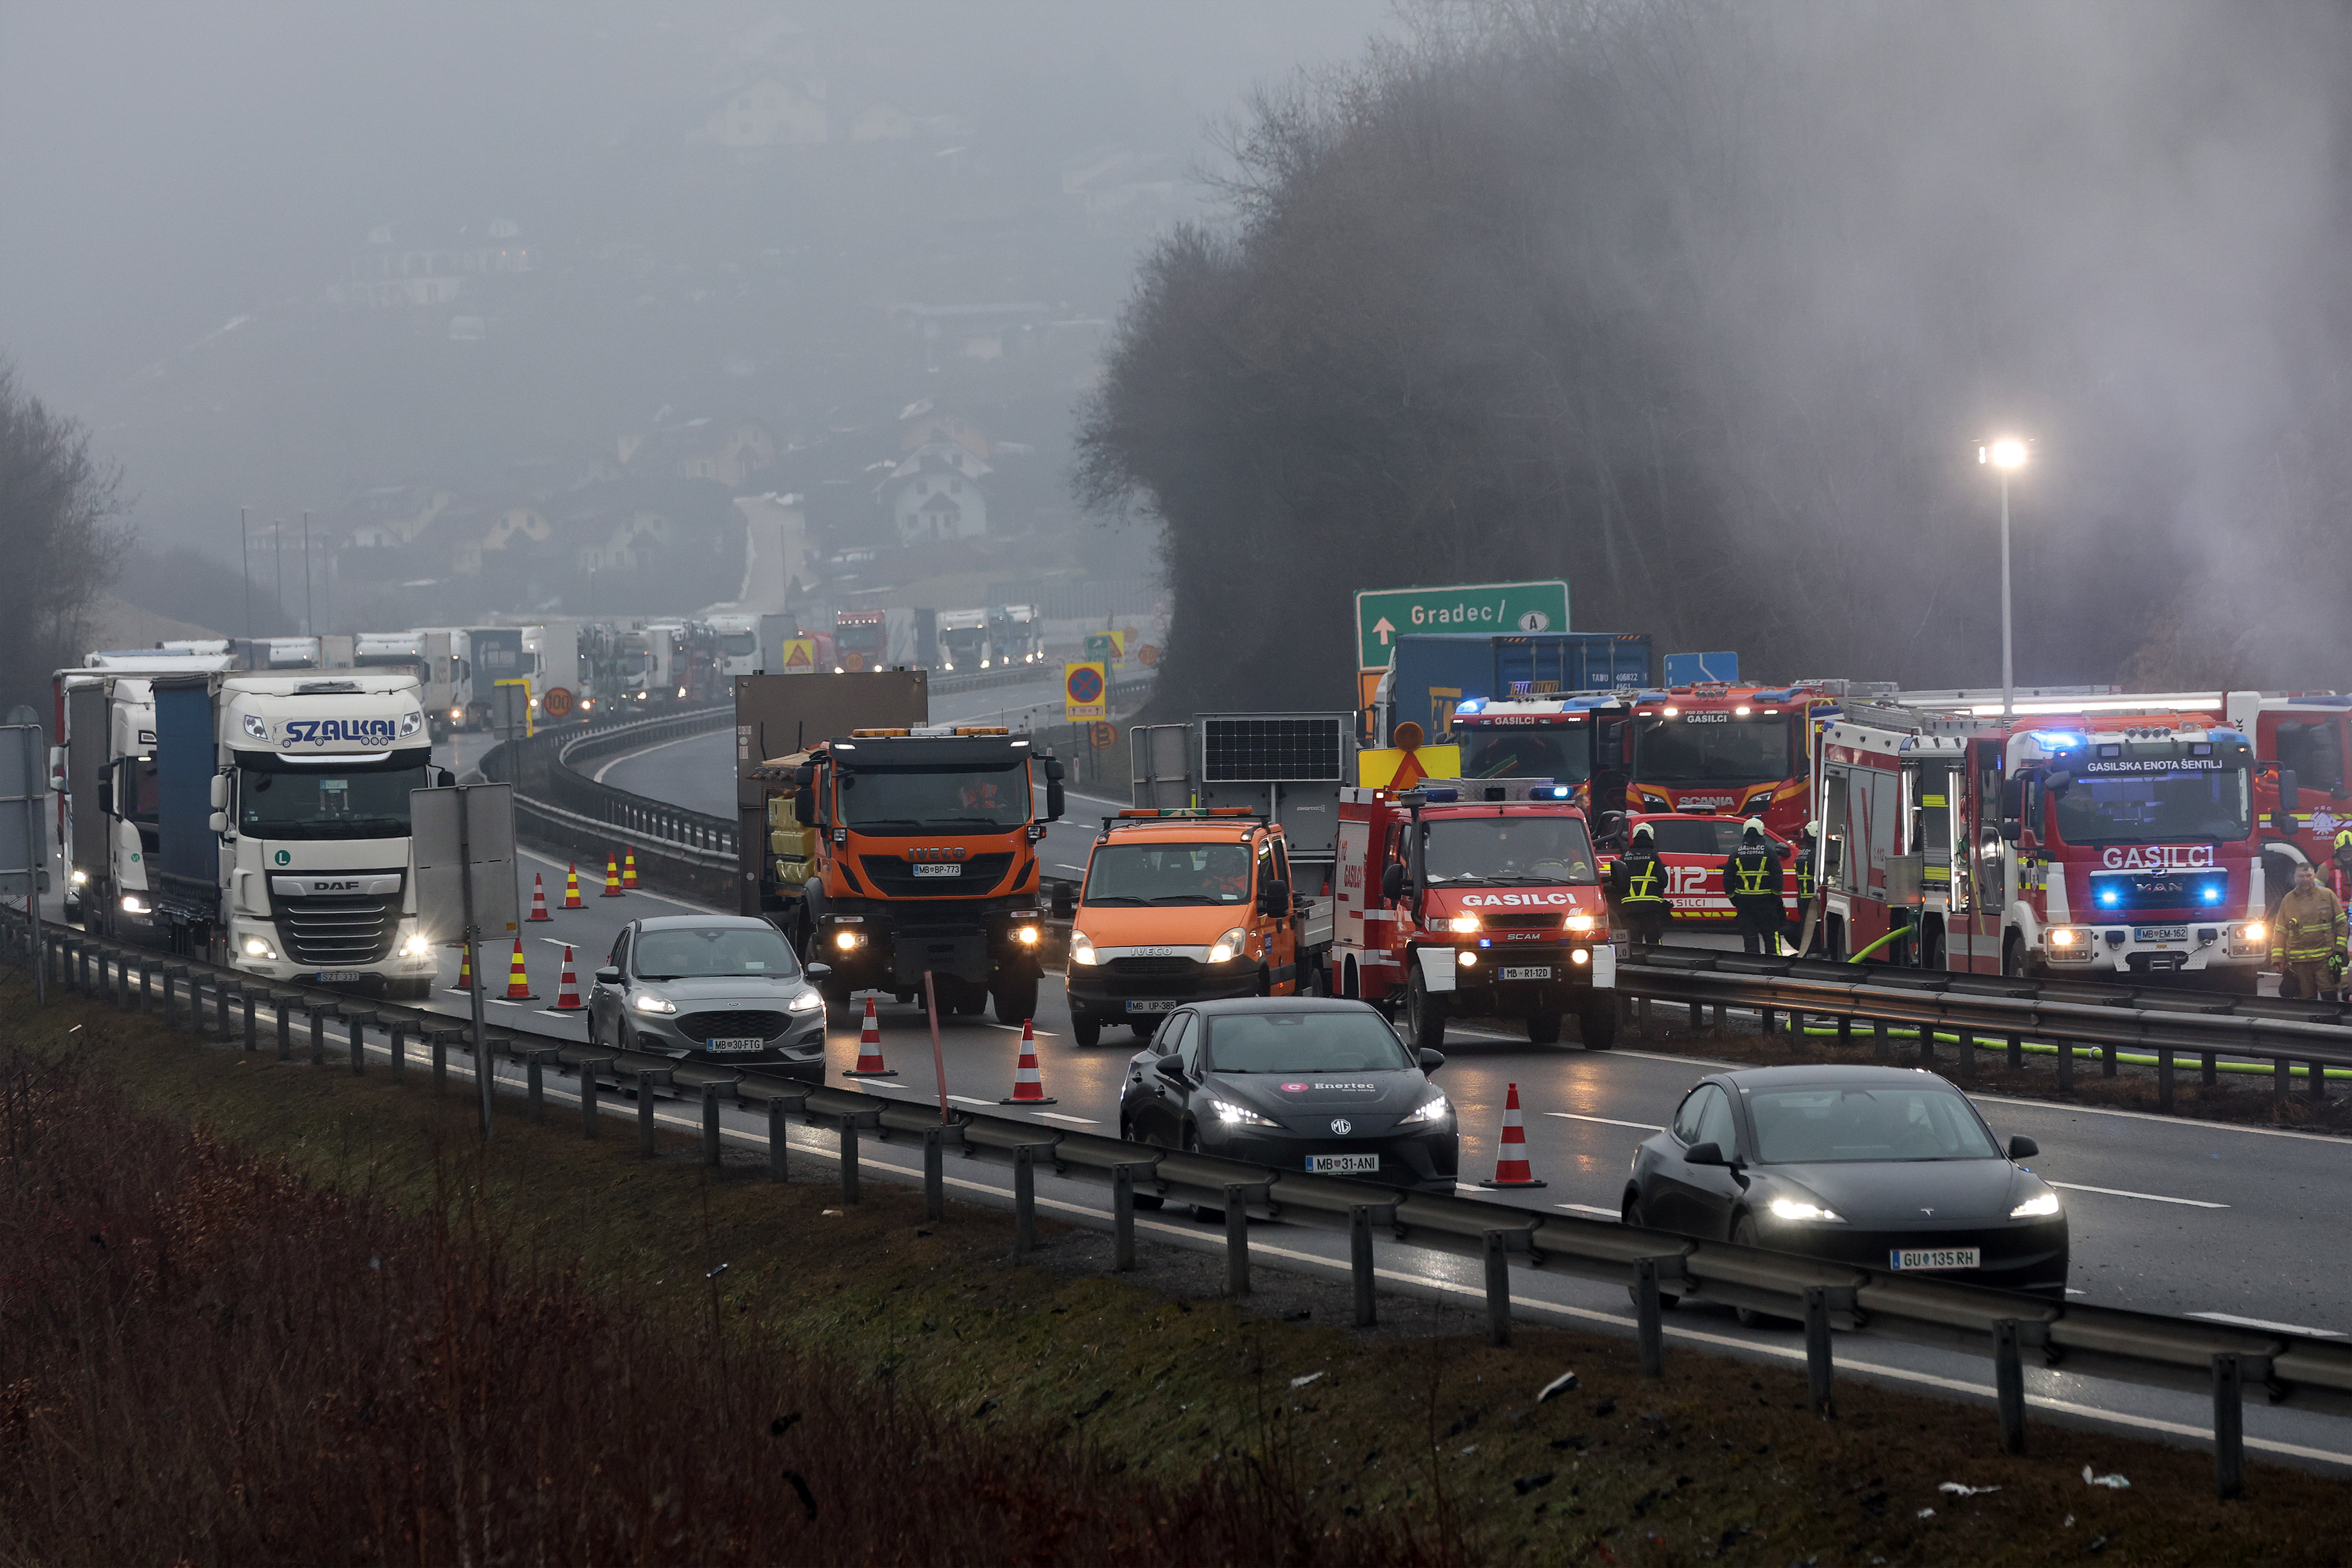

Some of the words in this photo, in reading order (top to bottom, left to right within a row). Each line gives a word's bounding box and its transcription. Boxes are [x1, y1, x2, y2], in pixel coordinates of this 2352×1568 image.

[1529, 614, 1538, 630] A
[548, 694, 570, 710] 100
[1495, 717, 1535, 725] GASILCI
[1687, 715, 1727, 723] GASILCI
[286, 720, 395, 742] SZALKAI
[2087, 762, 2142, 772] GASILSKA
[2144, 760, 2180, 770] ENOTA
[2181, 759, 2223, 769] ŠENTILJ
[1679, 796, 1735, 806] SCANIA
[278, 852, 287, 864] L
[908, 847, 966, 859] IVECO
[2103, 846, 2214, 869] GASILCI
[314, 881, 359, 890] DAF
[2136, 883, 2183, 892] MAN
[1462, 893, 1576, 906] GASILCI
[2159, 929, 2186, 938] EM-162
[1131, 947, 1172, 956] IVECO
[1507, 969, 1517, 977] MB
[1525, 968, 1547, 977] R1-12D
[1149, 1001, 1175, 1010] UP-385
[715, 1039, 726, 1048] MB
[733, 1038, 760, 1049] 30-FTG
[1333, 1121, 1350, 1133] MG
[1317, 1159, 1332, 1170] MB
[1342, 1157, 1374, 1169] 31-ANI
[1905, 1253, 1920, 1266] GU
[1932, 1252, 1954, 1265] 135
[1957, 1252, 1973, 1264] RH
